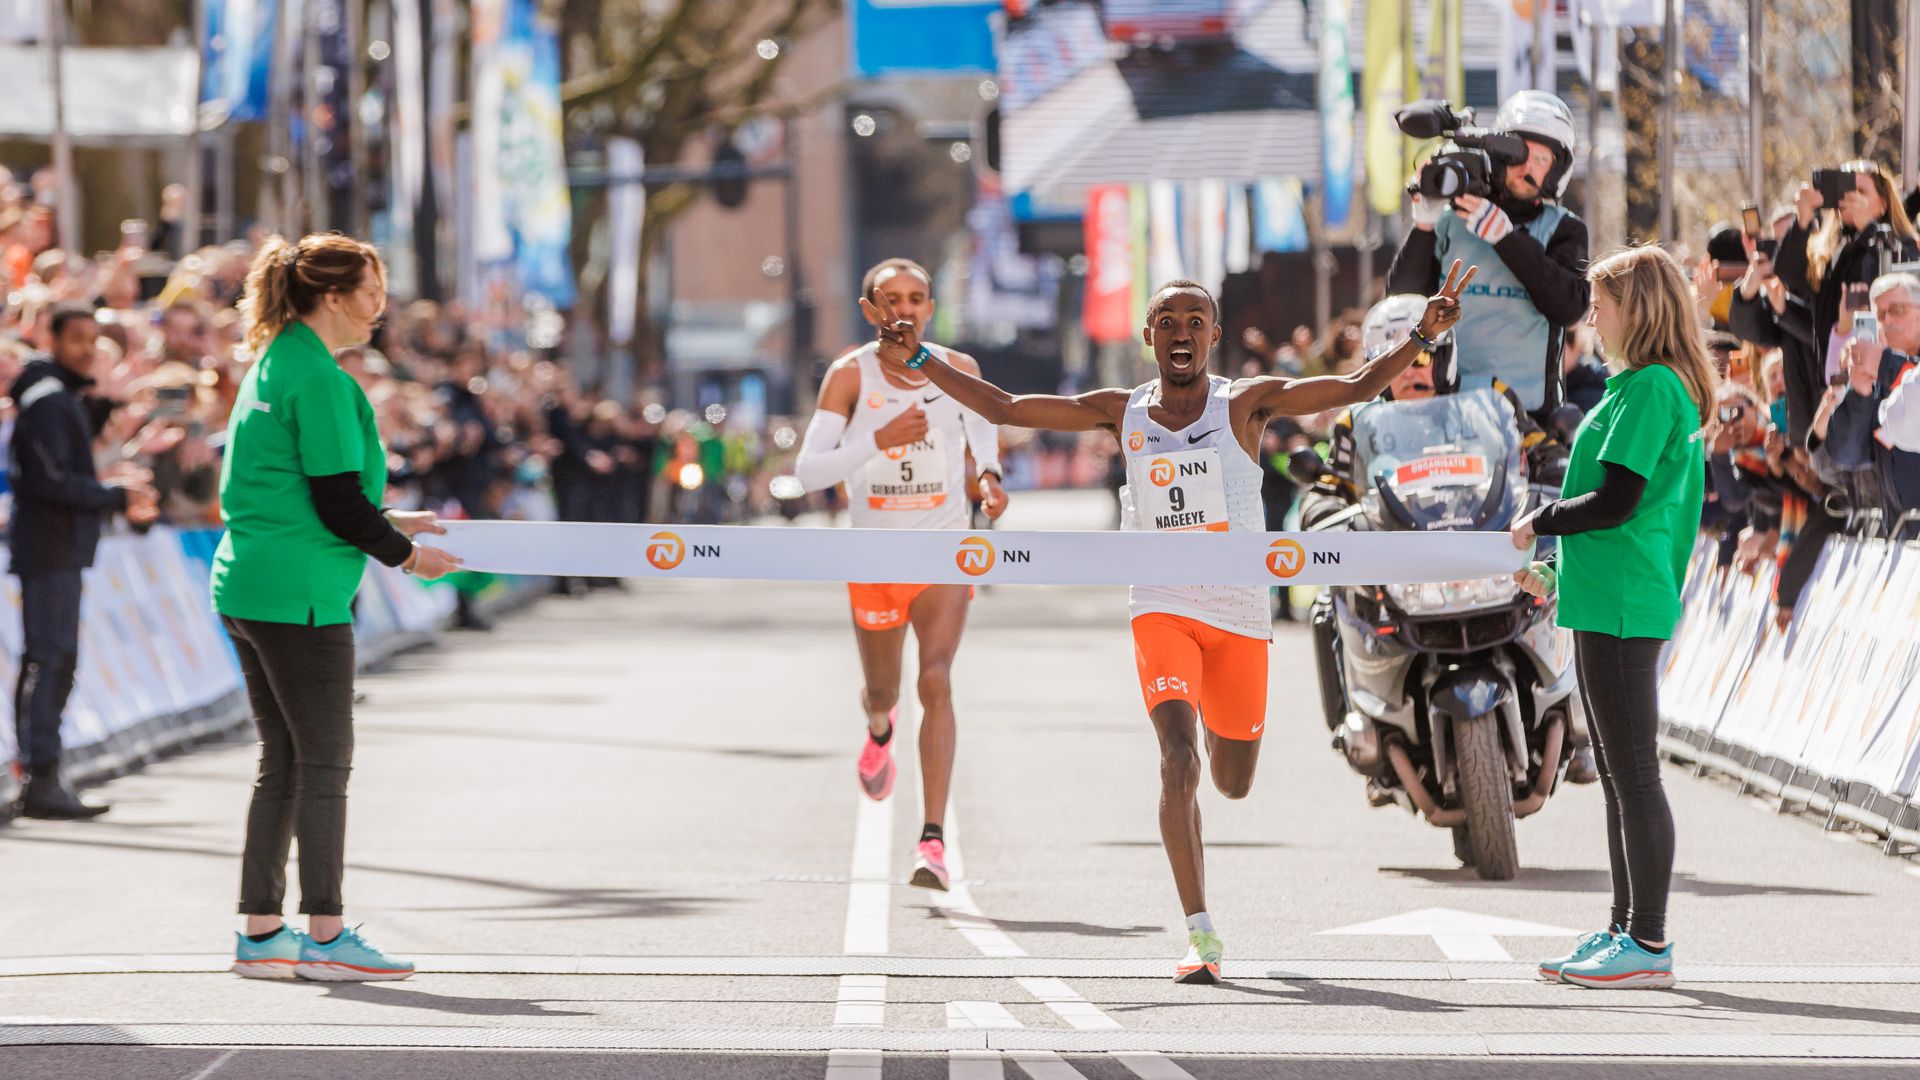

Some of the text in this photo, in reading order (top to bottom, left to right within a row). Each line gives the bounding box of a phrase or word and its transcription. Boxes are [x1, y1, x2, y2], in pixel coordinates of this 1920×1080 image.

[901, 461, 913, 482] 5
[1179, 461, 1208, 477] NN
[1168, 486, 1186, 512] 9
[1155, 511, 1206, 530] NAGEEYE
[693, 545, 721, 558] NN
[1003, 550, 1031, 563] NN
[1313, 551, 1341, 565] NN
